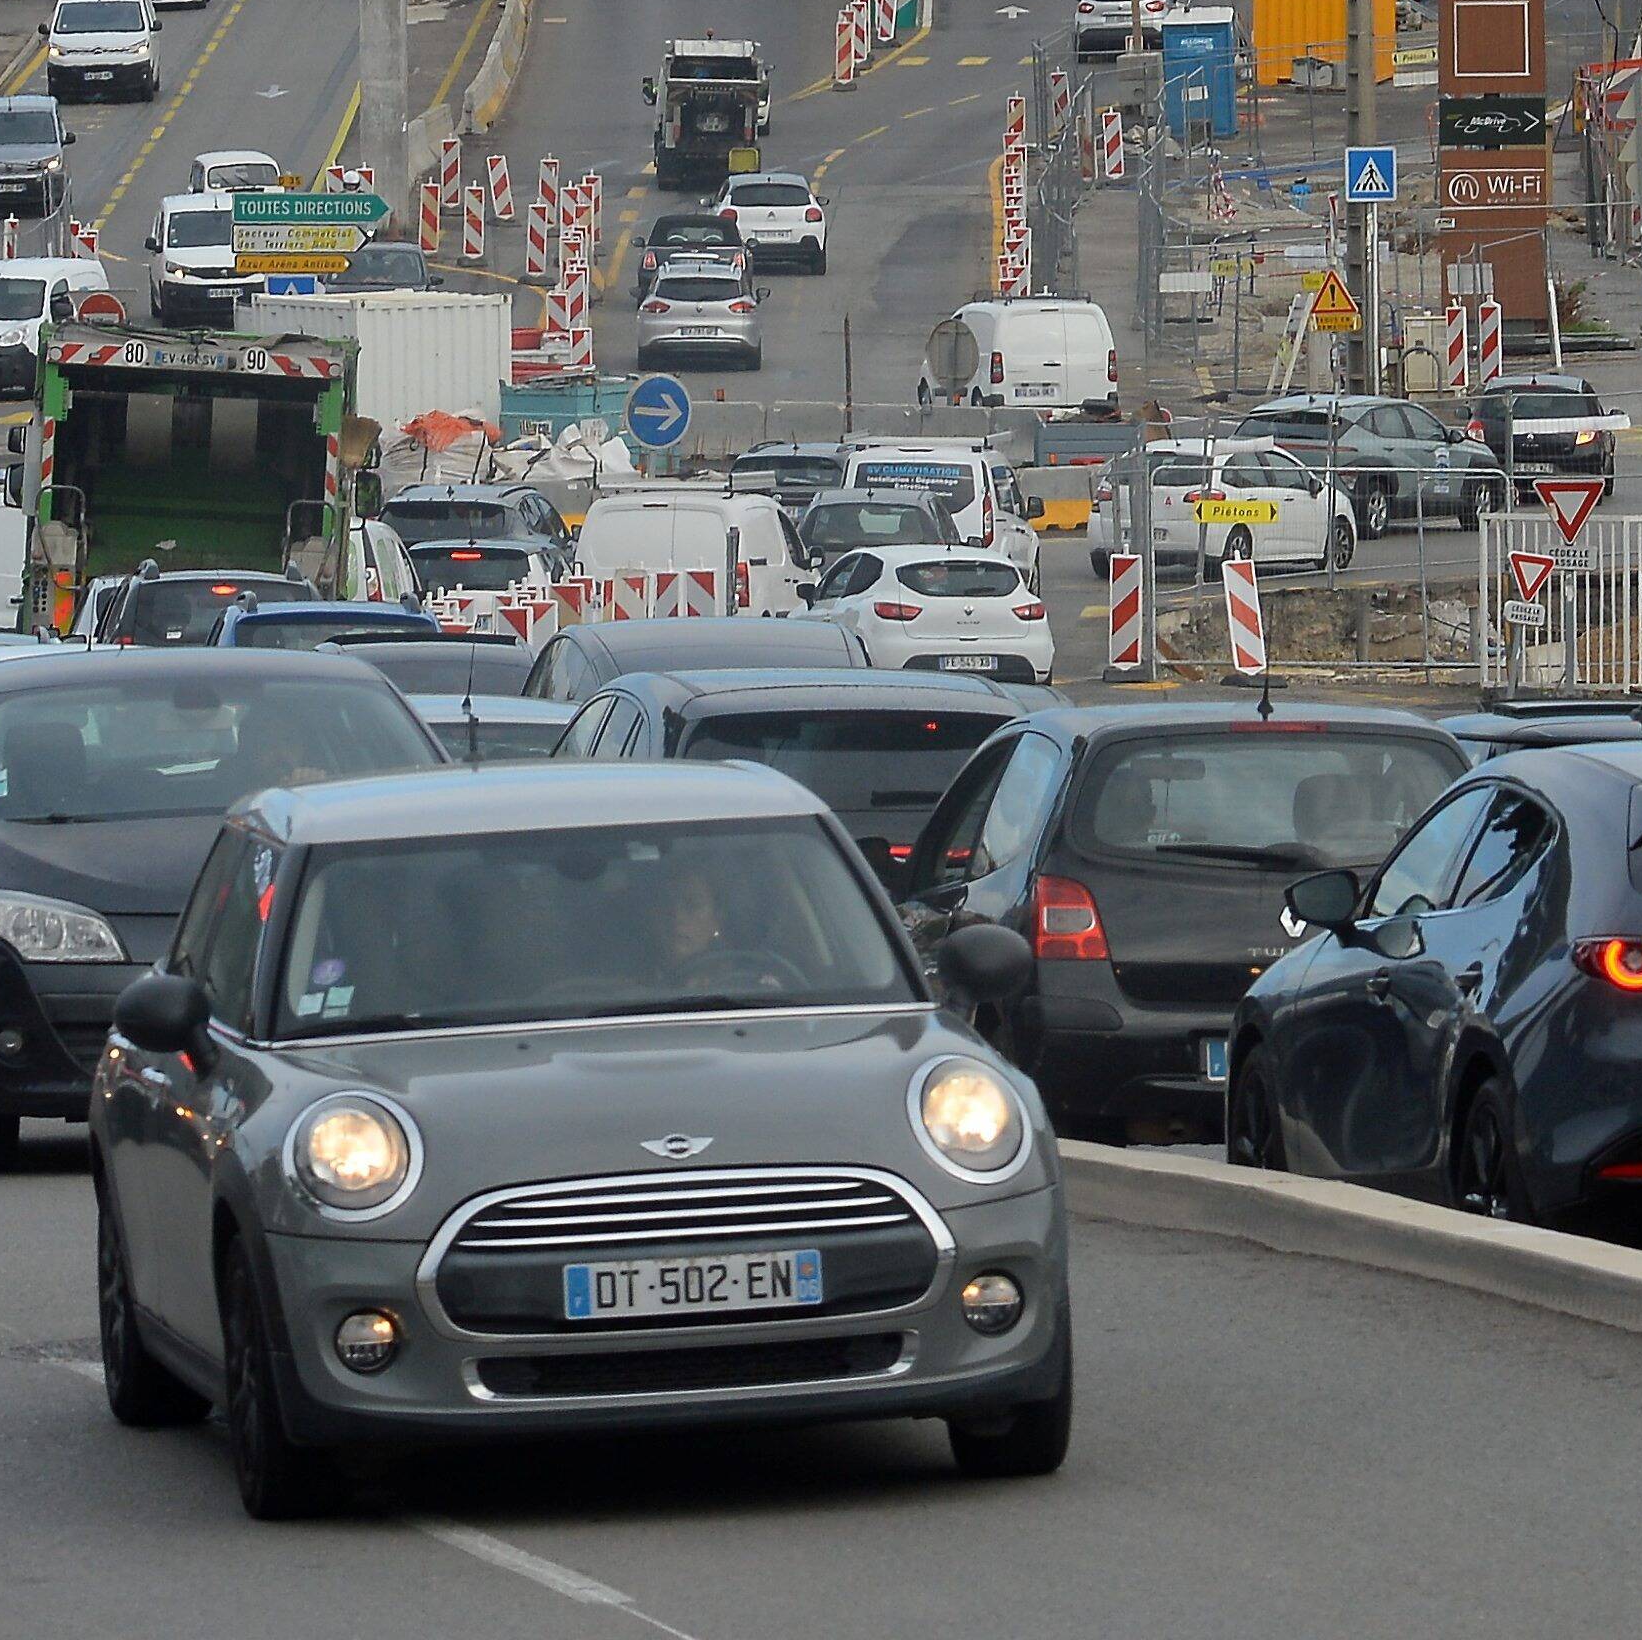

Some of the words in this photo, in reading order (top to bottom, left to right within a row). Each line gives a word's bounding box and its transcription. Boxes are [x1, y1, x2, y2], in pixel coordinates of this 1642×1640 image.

[1487, 175, 1541, 194] Wi-Fi
[240, 201, 290, 215] TOUTES
[294, 200, 372, 216] DIRECTIONS
[238, 228, 280, 239] Secteur
[287, 227, 352, 239] Commercial
[237, 239, 255, 249] des
[266, 239, 304, 249] Terriers
[240, 259, 263, 269] Azur
[126, 343, 145, 363] 80
[246, 349, 266, 371] 90
[1212, 506, 1260, 517] Piétons
[1579, 548, 1589, 558] LE
[1556, 559, 1589, 568] ASSAGE
[596, 1259, 792, 1308] DT-502-EN
